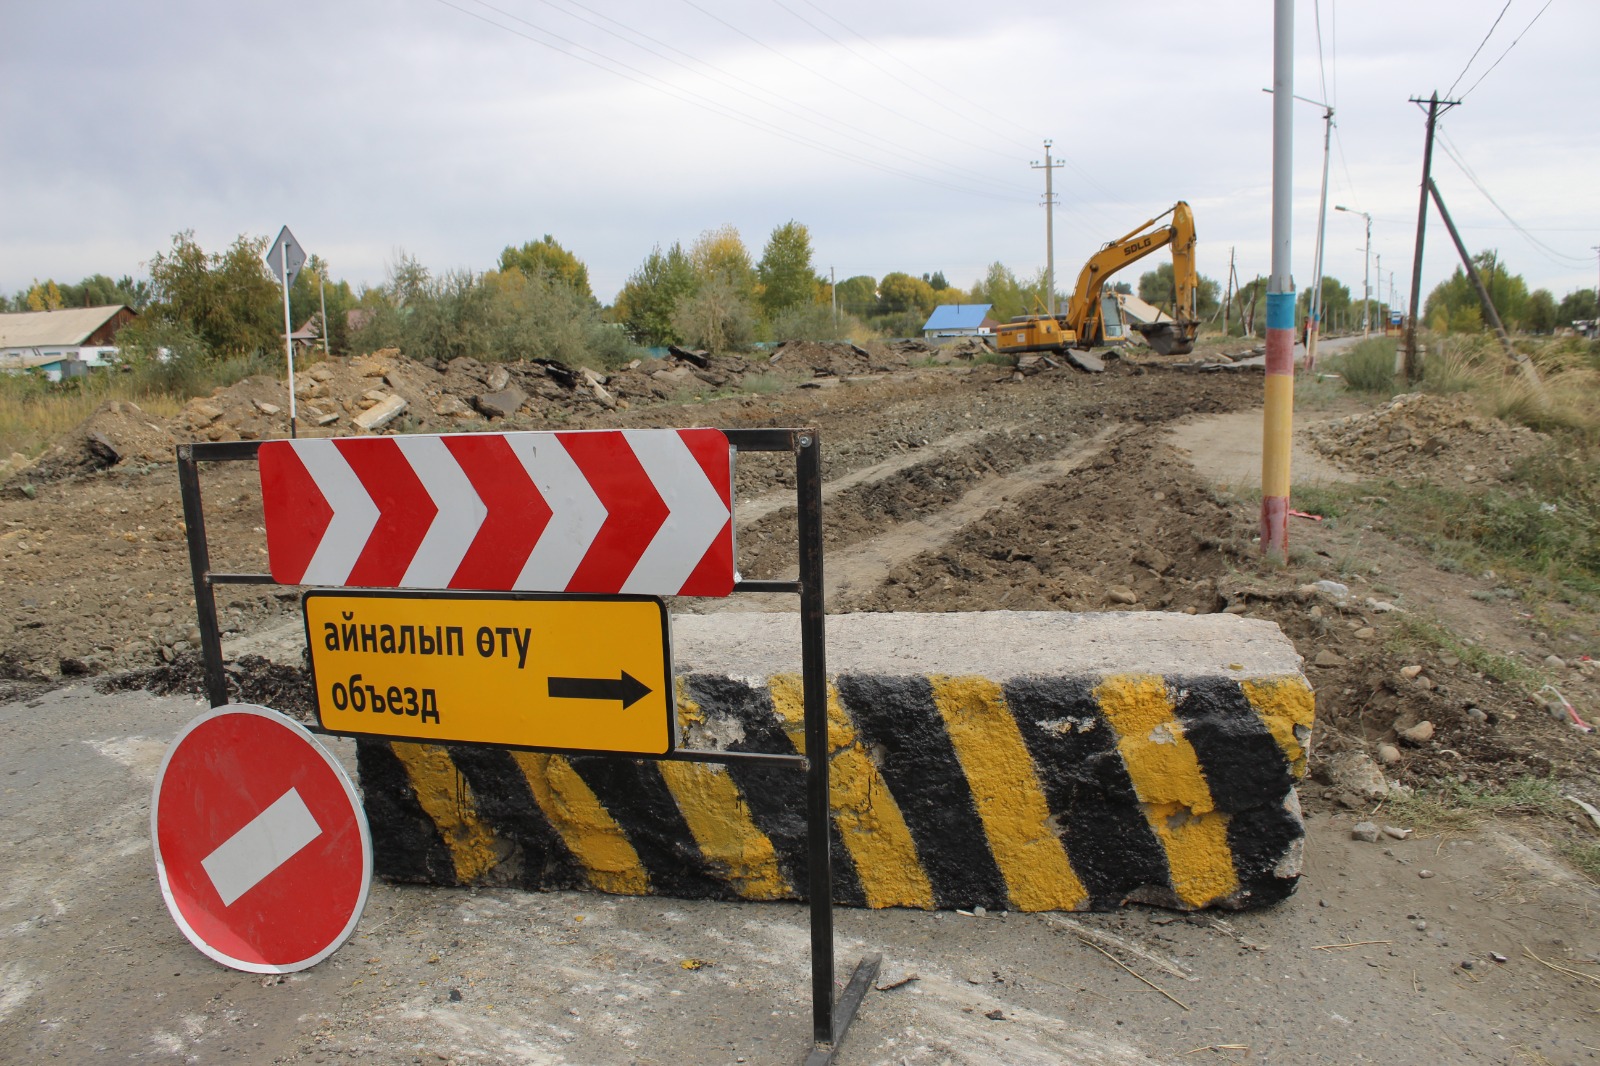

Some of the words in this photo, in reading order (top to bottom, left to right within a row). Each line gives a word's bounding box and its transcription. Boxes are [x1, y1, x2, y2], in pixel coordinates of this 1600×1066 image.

[1123, 238, 1152, 256] SDLG
[324, 611, 464, 657] айналып
[476, 626, 532, 669] өту
[331, 674, 441, 725] объезд
